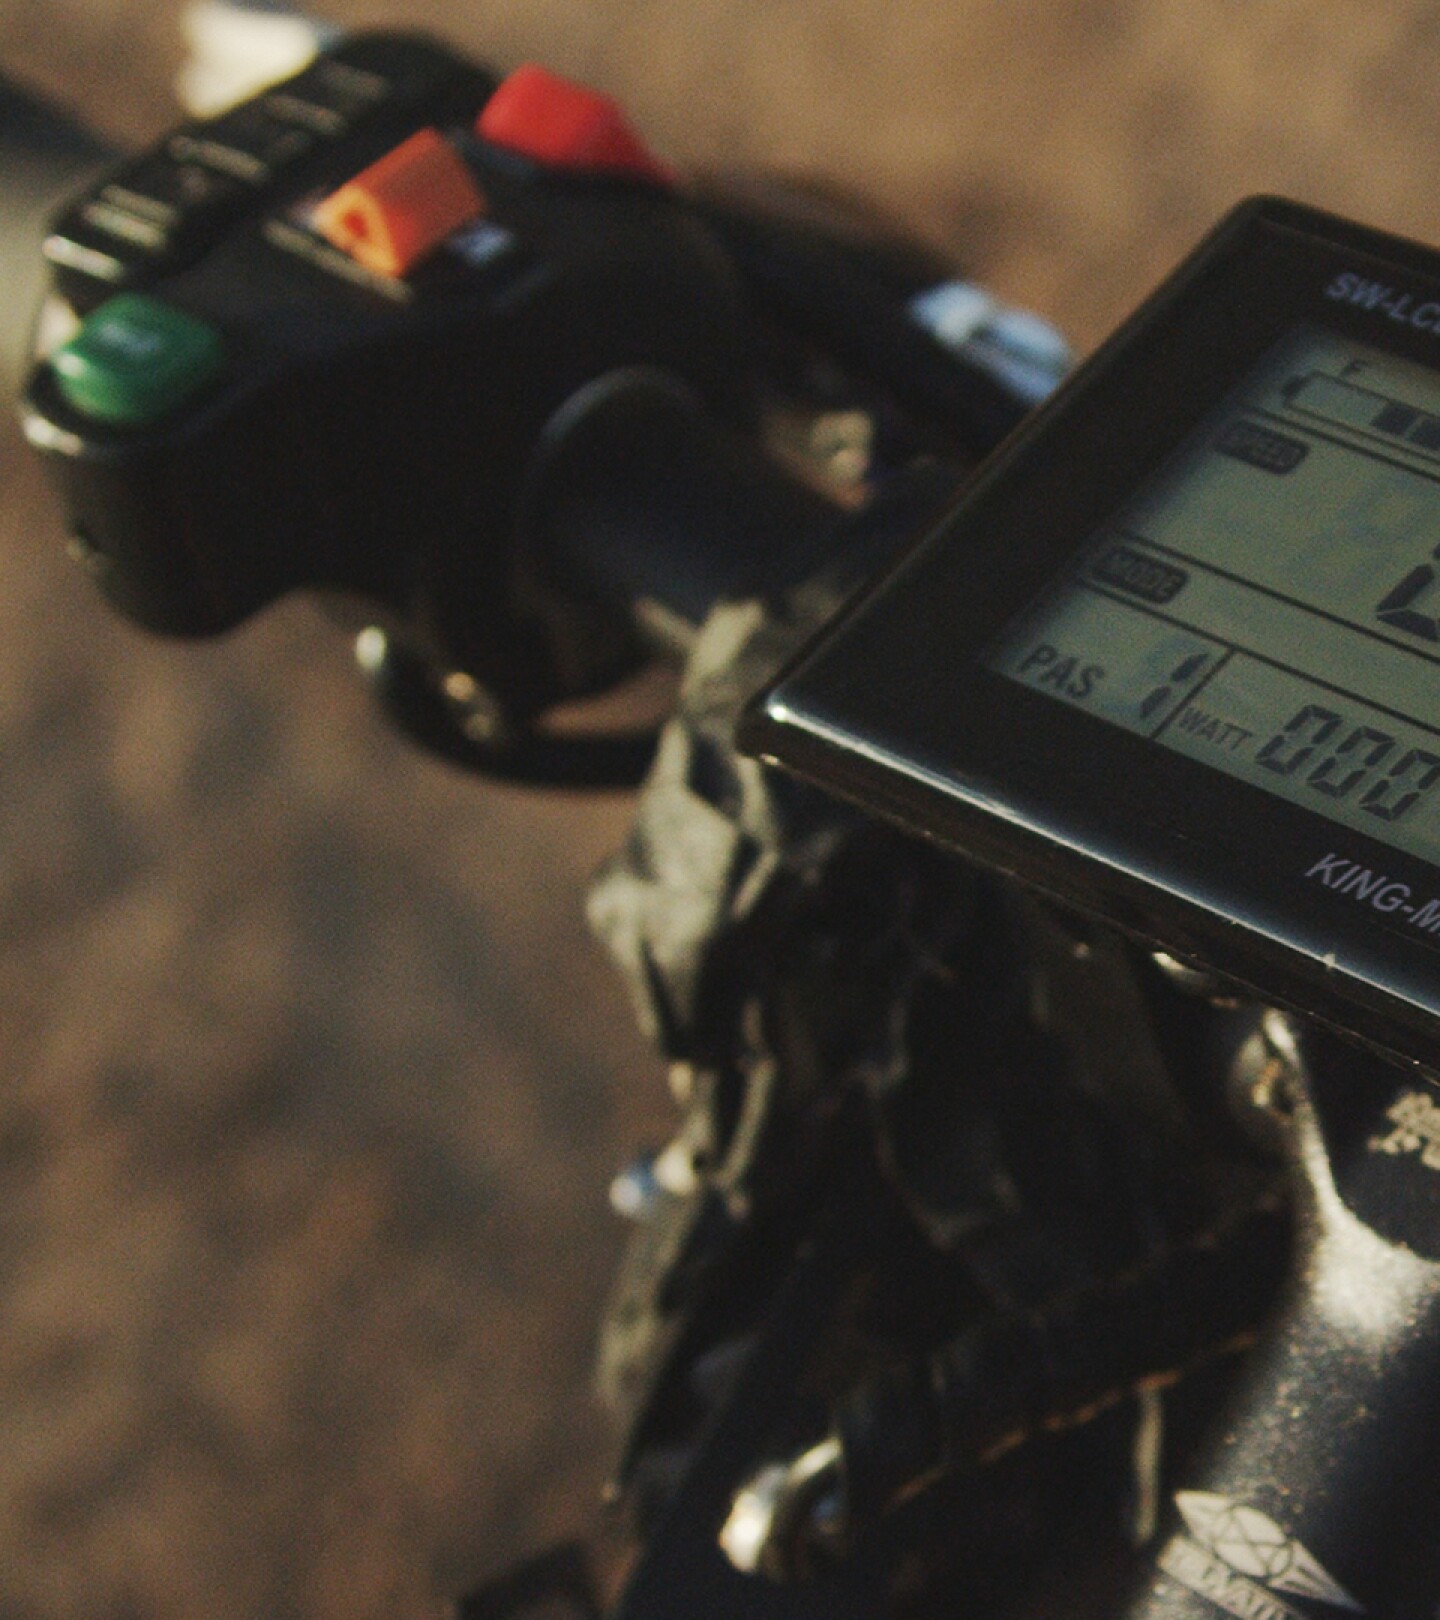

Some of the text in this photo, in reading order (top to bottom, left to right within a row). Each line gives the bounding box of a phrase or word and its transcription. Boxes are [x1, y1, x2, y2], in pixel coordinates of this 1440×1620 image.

[1341, 360, 1369, 377] F
[1018, 644, 1209, 719] PAS 1
[1177, 706, 1254, 753] WATT
